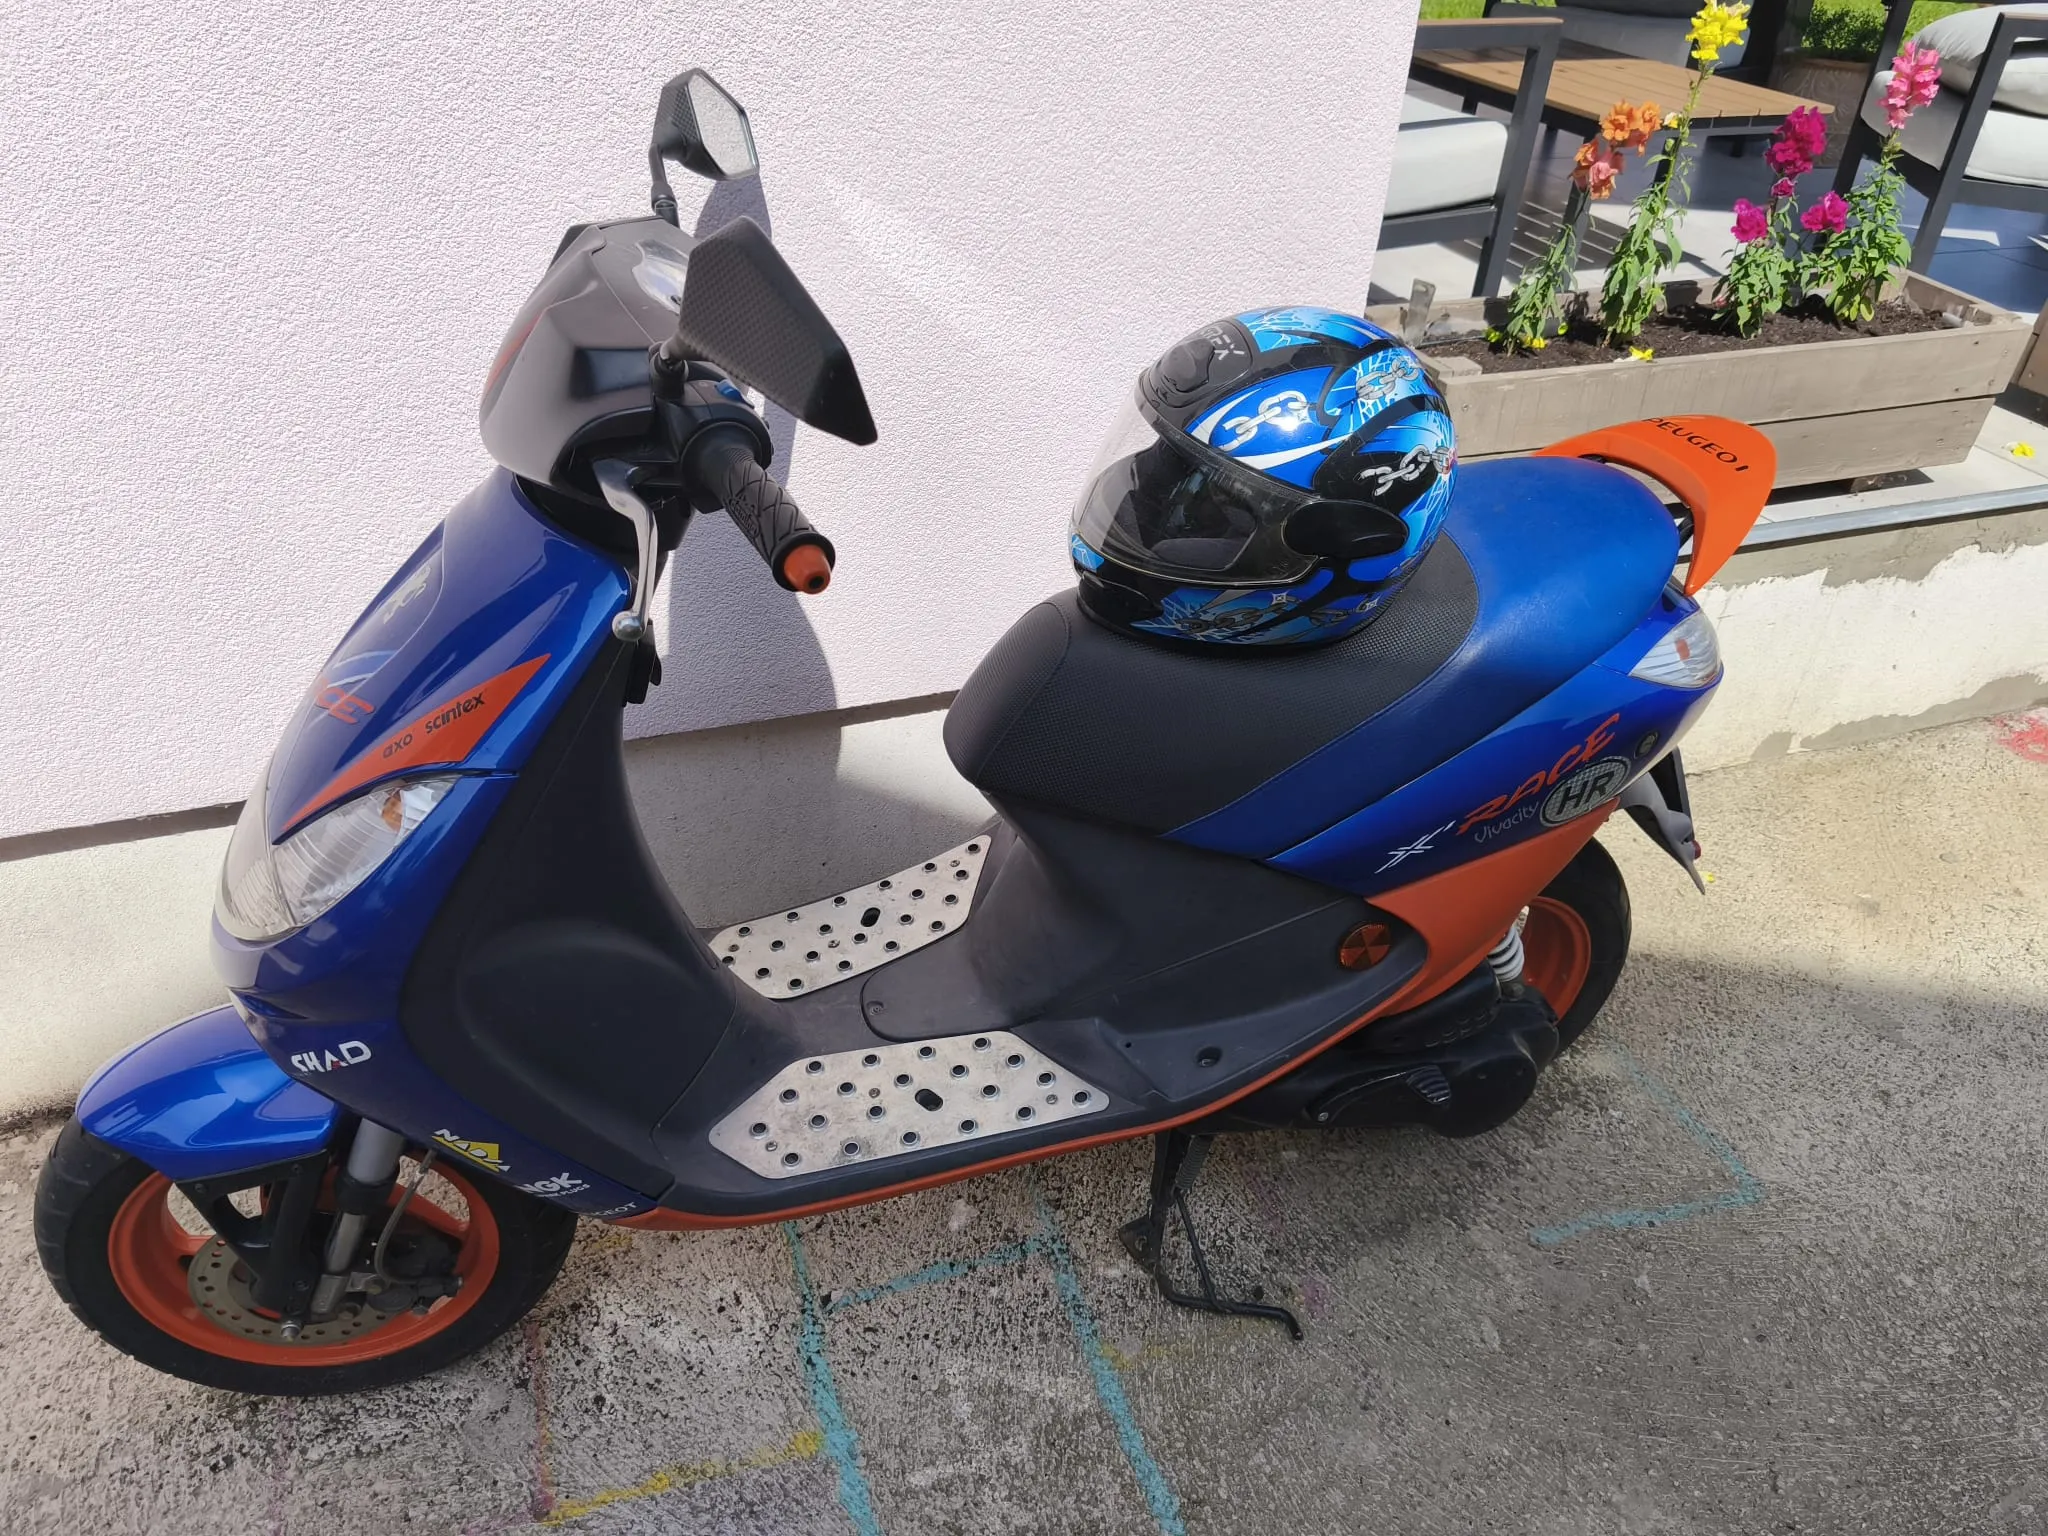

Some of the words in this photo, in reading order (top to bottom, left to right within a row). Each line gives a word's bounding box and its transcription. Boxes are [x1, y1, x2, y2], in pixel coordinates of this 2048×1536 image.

[383, 733, 413, 759] axo
[425, 692, 486, 734] scintex
[1555, 770, 1616, 816] HR
[1474, 802, 1540, 844] Vivacity
[291, 1040, 372, 1073] SHAD
[516, 1172, 582, 1193] NGK
